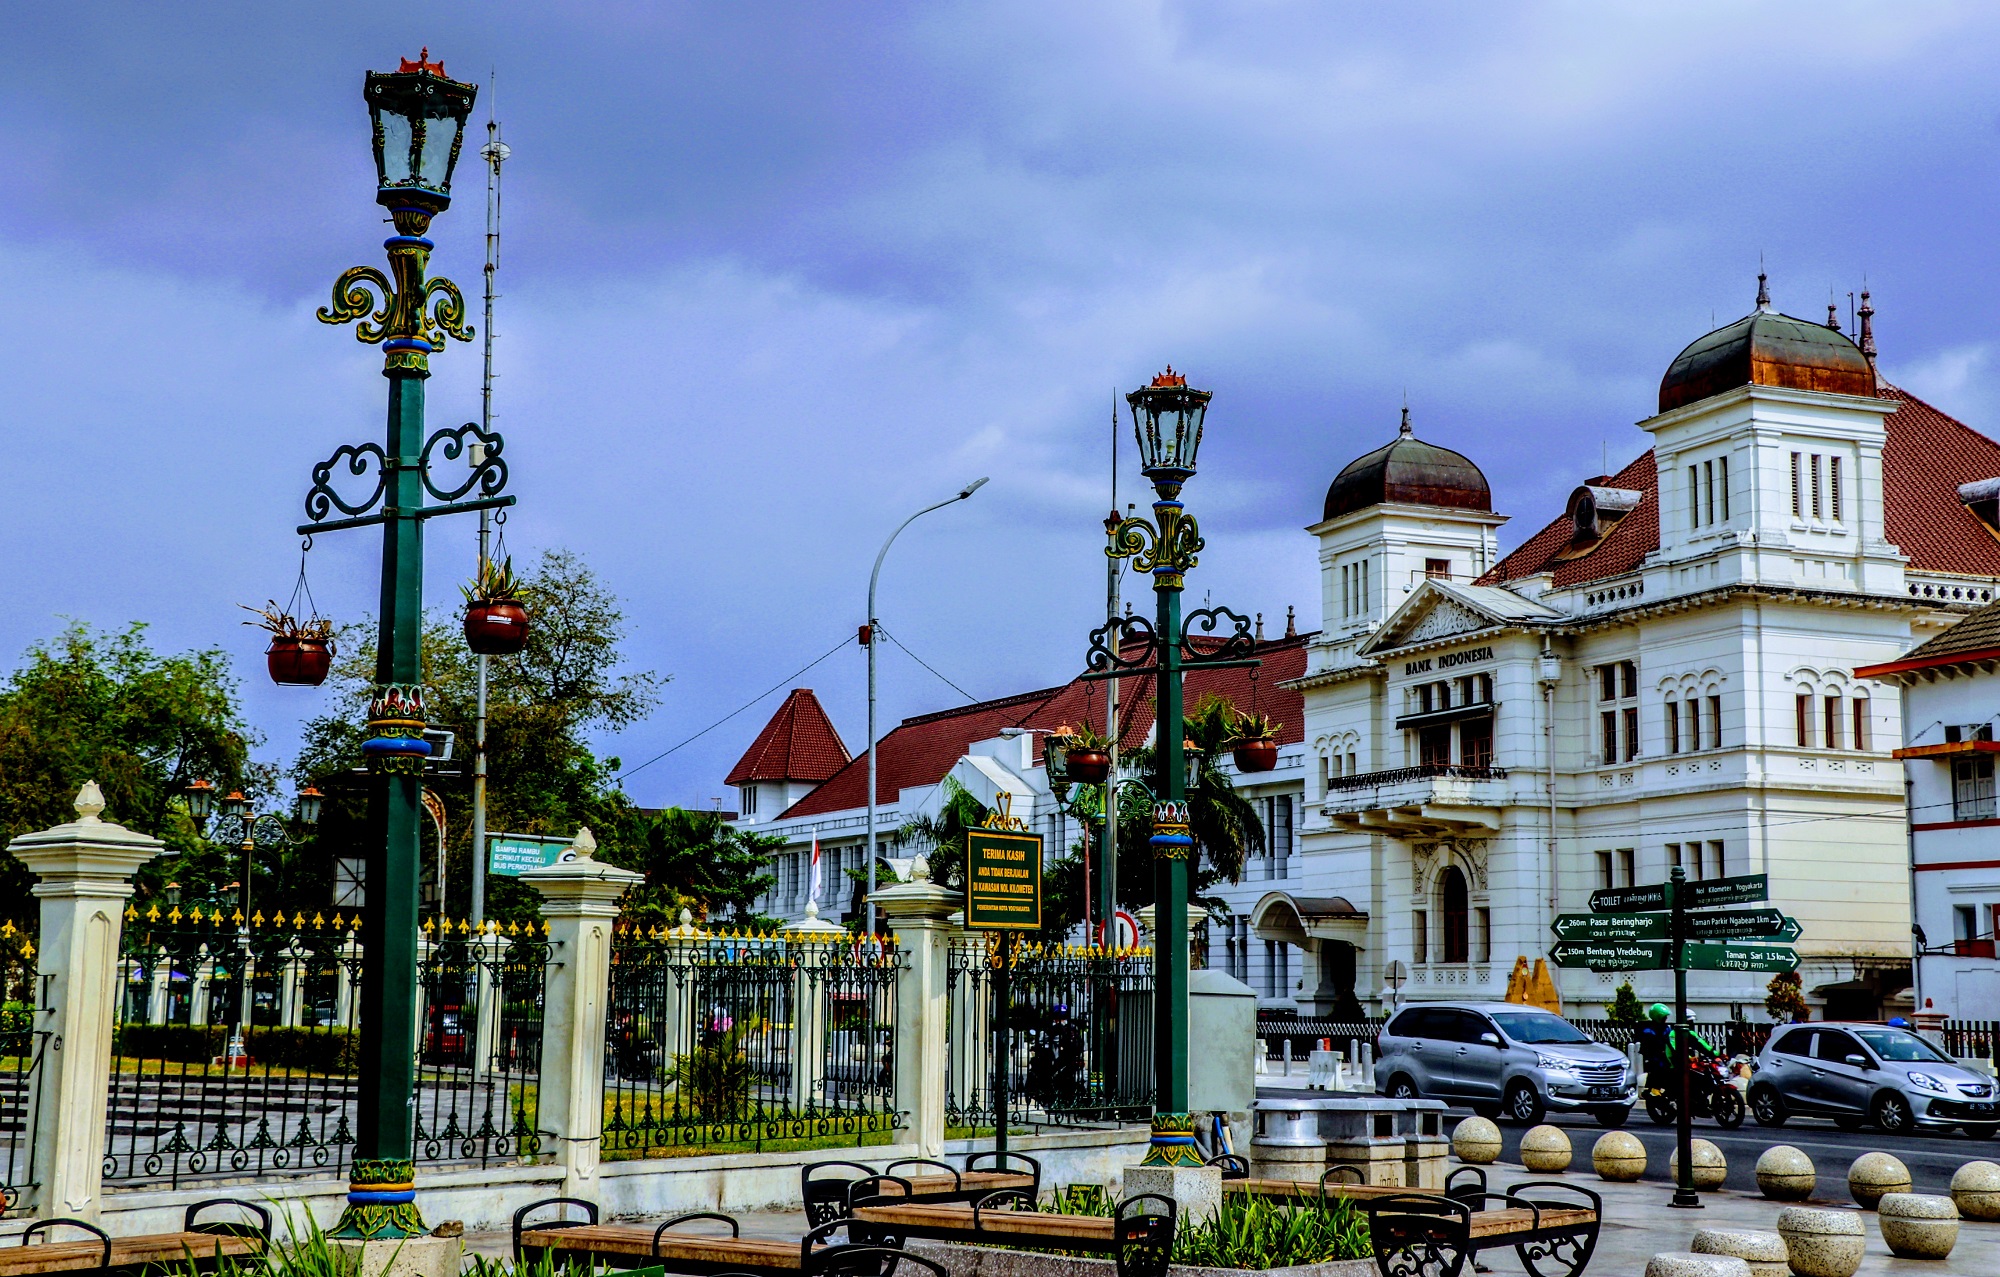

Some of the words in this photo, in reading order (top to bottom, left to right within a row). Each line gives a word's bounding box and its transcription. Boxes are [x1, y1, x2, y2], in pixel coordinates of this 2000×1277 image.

[1405, 659, 1432, 675] BANK
[1438, 646, 1493, 669] INDONESIA
[495, 845, 517, 854] SAMPAI
[518, 846, 540, 855] RAMBU
[982, 848, 1005, 860] TERIMA
[1006, 850, 1025, 861] KASIH
[494, 853, 520, 862] BERIKUT
[507, 863, 542, 871] PERKOTAA
[978, 867, 990, 876] ANDA
[991, 867, 1004, 877] TIDAK
[1004, 868, 1029, 878] BERJUALAN
[973, 882, 978, 891] DI
[979, 882, 1000, 892] KAWASAN
[1000, 883, 1009, 893] NOL
[1009, 884, 1034, 894] KILOMETER
[1708, 885, 1732, 894] Kilometer
[1735, 882, 1763, 892] Yogyakarta
[1600, 896, 1621, 906] TOILET
[1569, 919, 1587, 927] 260m
[1590, 918, 1609, 926] Pasar
[1612, 917, 1653, 928] Beringharjo
[1692, 918, 1711, 926] Taman
[1729, 917, 1756, 927] Ngabean
[1586, 947, 1615, 957] Benteng
[1616, 947, 1653, 958] Vredeburg
[1725, 950, 1747, 959] Taman
[1750, 952, 1763, 960] Sari
